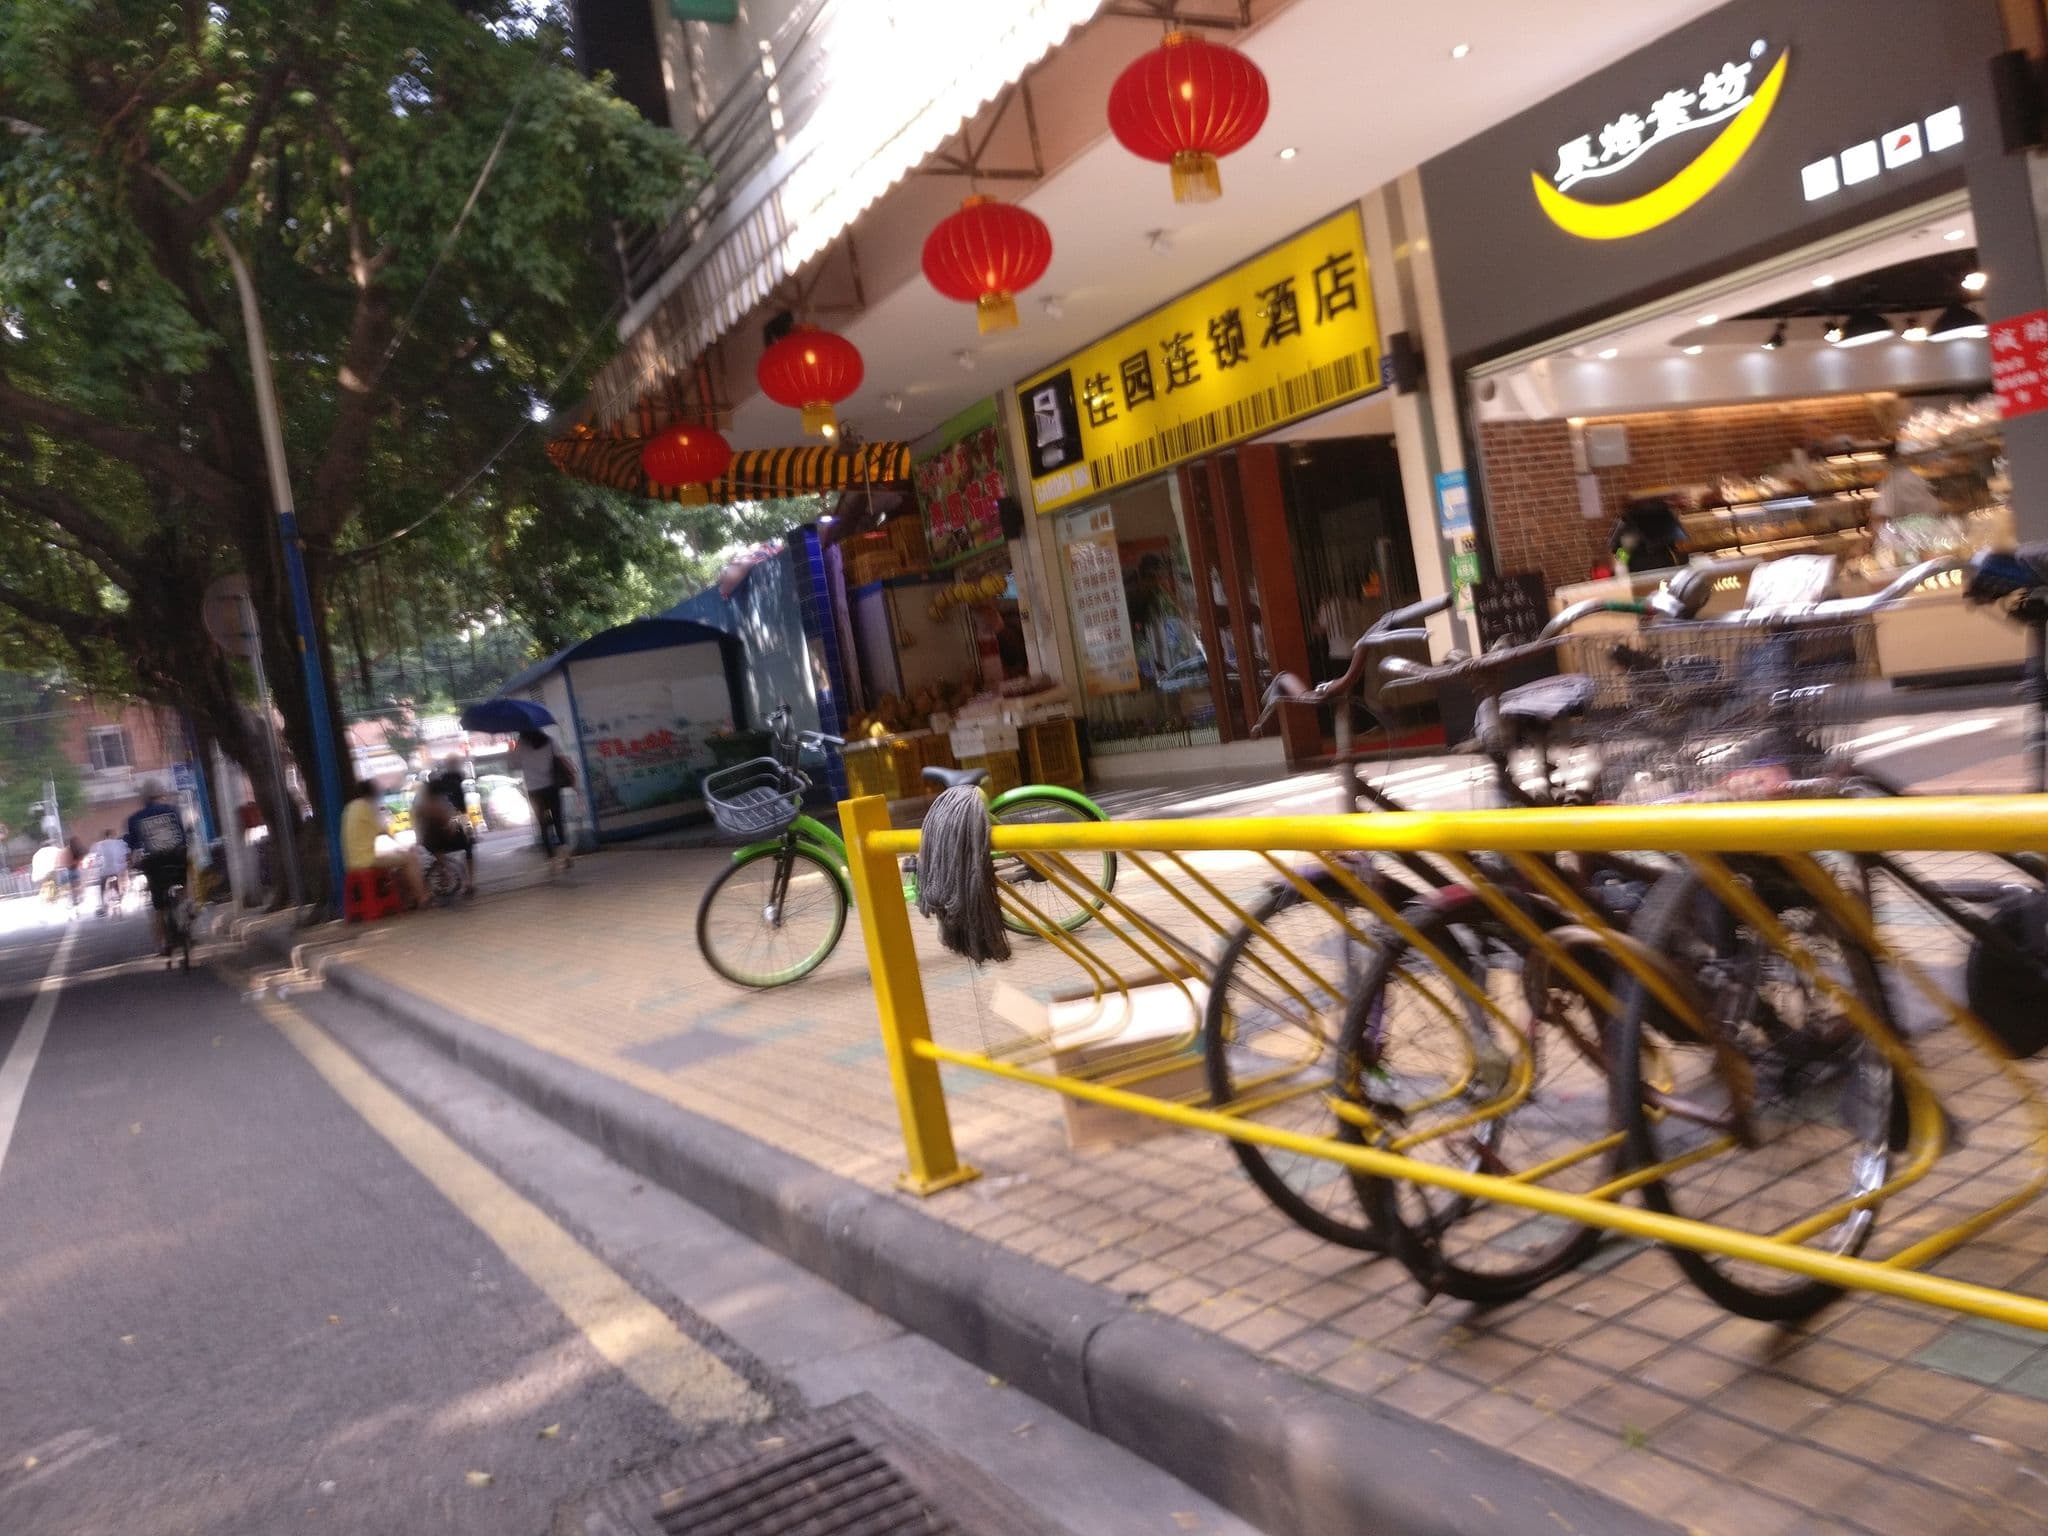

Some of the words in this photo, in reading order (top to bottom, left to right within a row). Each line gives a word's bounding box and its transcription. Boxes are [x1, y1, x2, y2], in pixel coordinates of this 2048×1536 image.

[1082, 250, 1359, 429] 佳园连锁酒店
